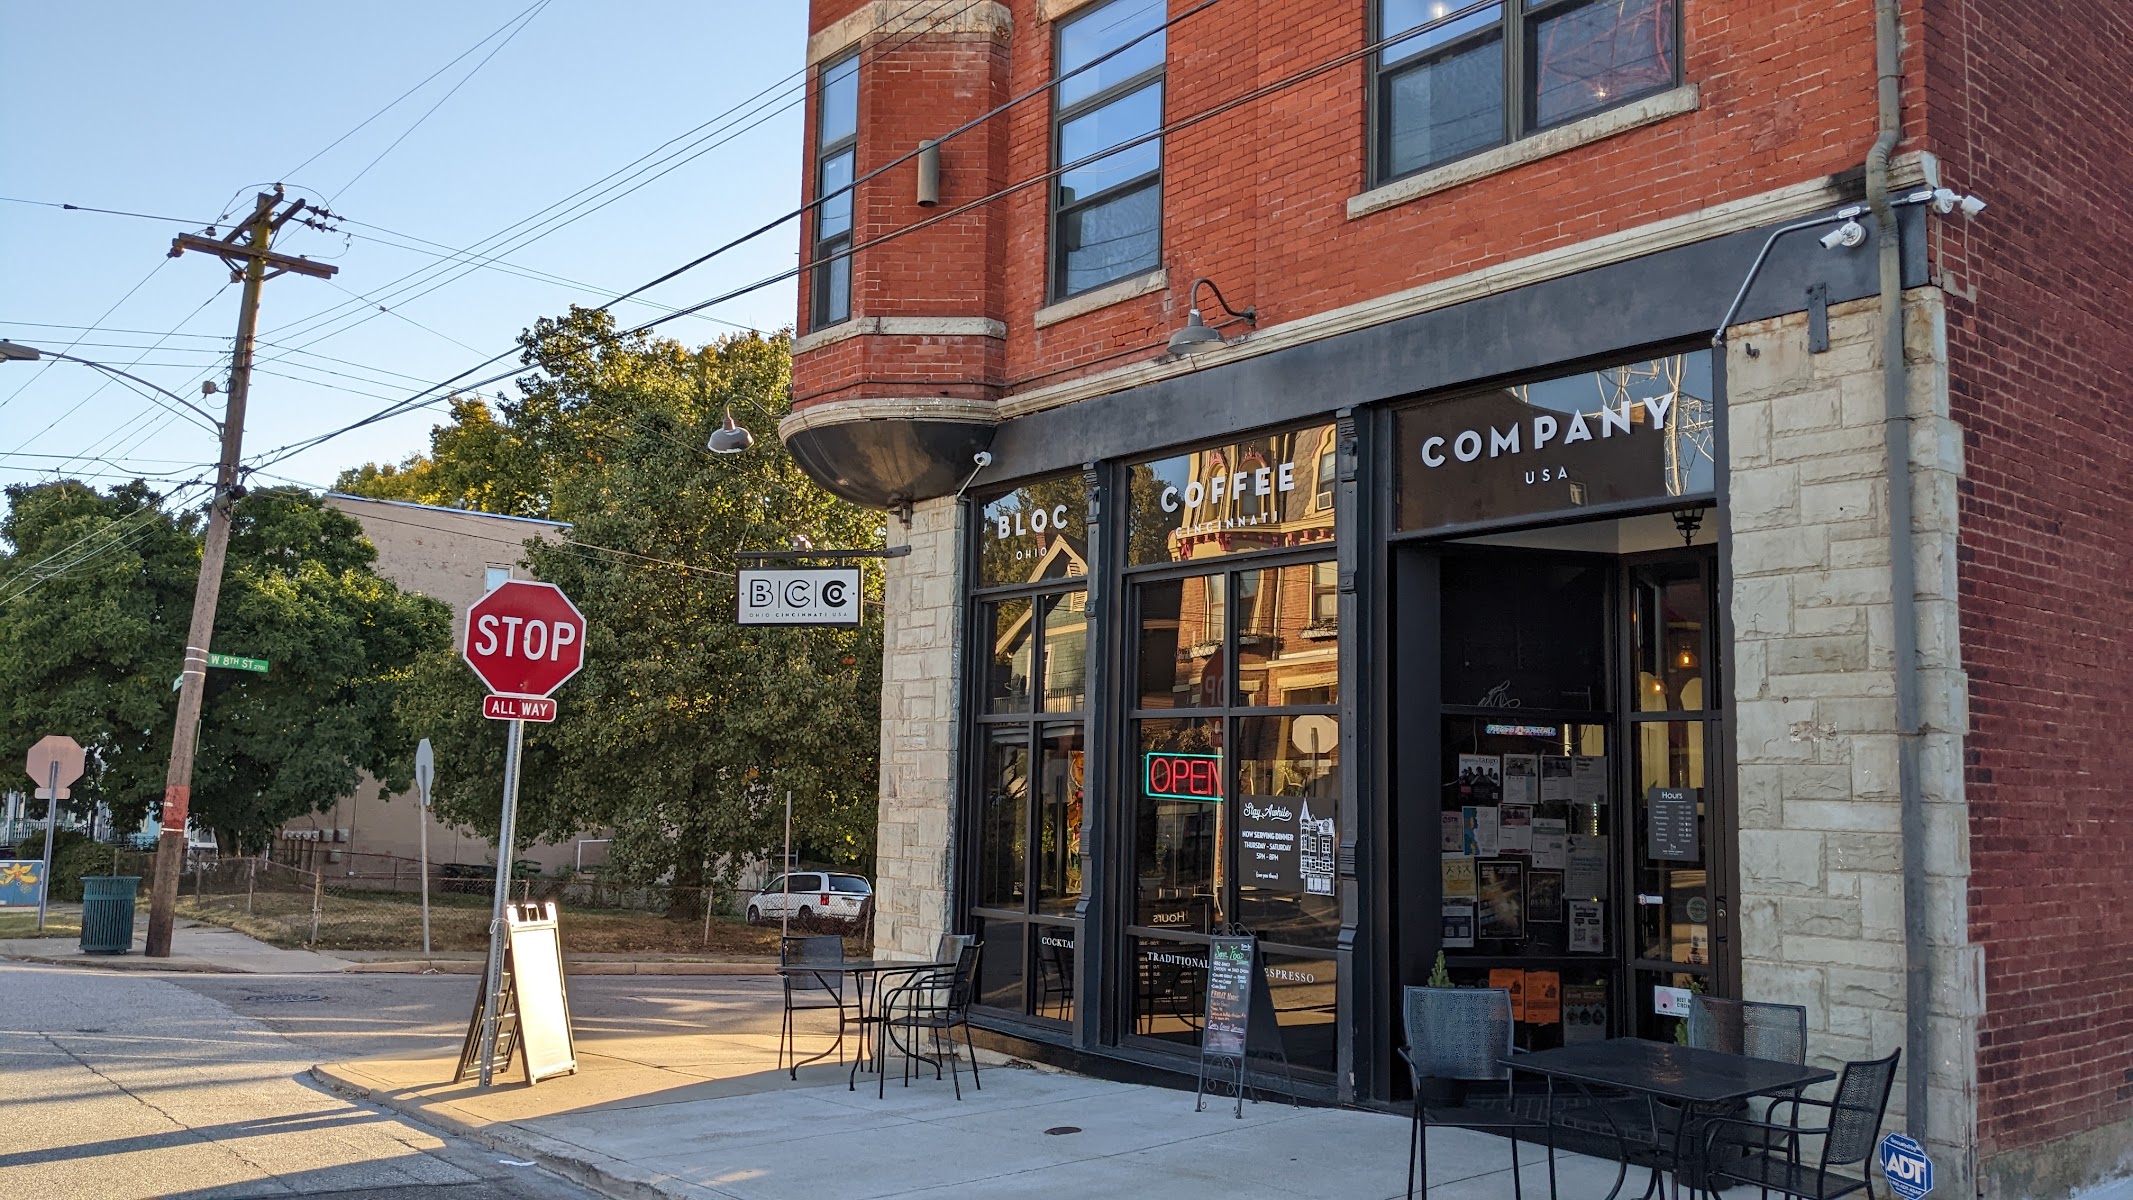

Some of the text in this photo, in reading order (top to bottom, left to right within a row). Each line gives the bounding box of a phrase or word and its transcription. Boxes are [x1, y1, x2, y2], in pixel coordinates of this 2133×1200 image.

[1421, 392, 1674, 468] COMPANY
[1525, 466, 1568, 484] USA
[1161, 462, 1295, 512] COFFEE
[998, 504, 1068, 539] BLOC
[1175, 511, 1278, 537] CINCINNATI
[1016, 547, 1047, 560] OHIO
[475, 614, 576, 662] STOP
[211, 655, 220, 665] W
[222, 656, 239, 666] 8TH
[241, 659, 254, 669] ST
[491, 700, 548, 717] ALL WAY
[1478, 757, 1499, 766] tango
[1150, 757, 1223, 796] OPEN
[1661, 791, 1683, 800] Hours
[1243, 802, 1293, 821] Stay Awhile
[1242, 830, 1294, 842] NOW SERVING DINNER
[1244, 841, 1266, 850] THURSDAY
[1270, 842, 1292, 851] SATURDAY
[1256, 852, 1265, 860] 5PM
[1268, 853, 1279, 861] 8PM
[1147, 951, 1209, 969] TRADITIONAL
[1264, 967, 1315, 984] ESPRESSO
[1886, 1152, 1925, 1184] ADT
